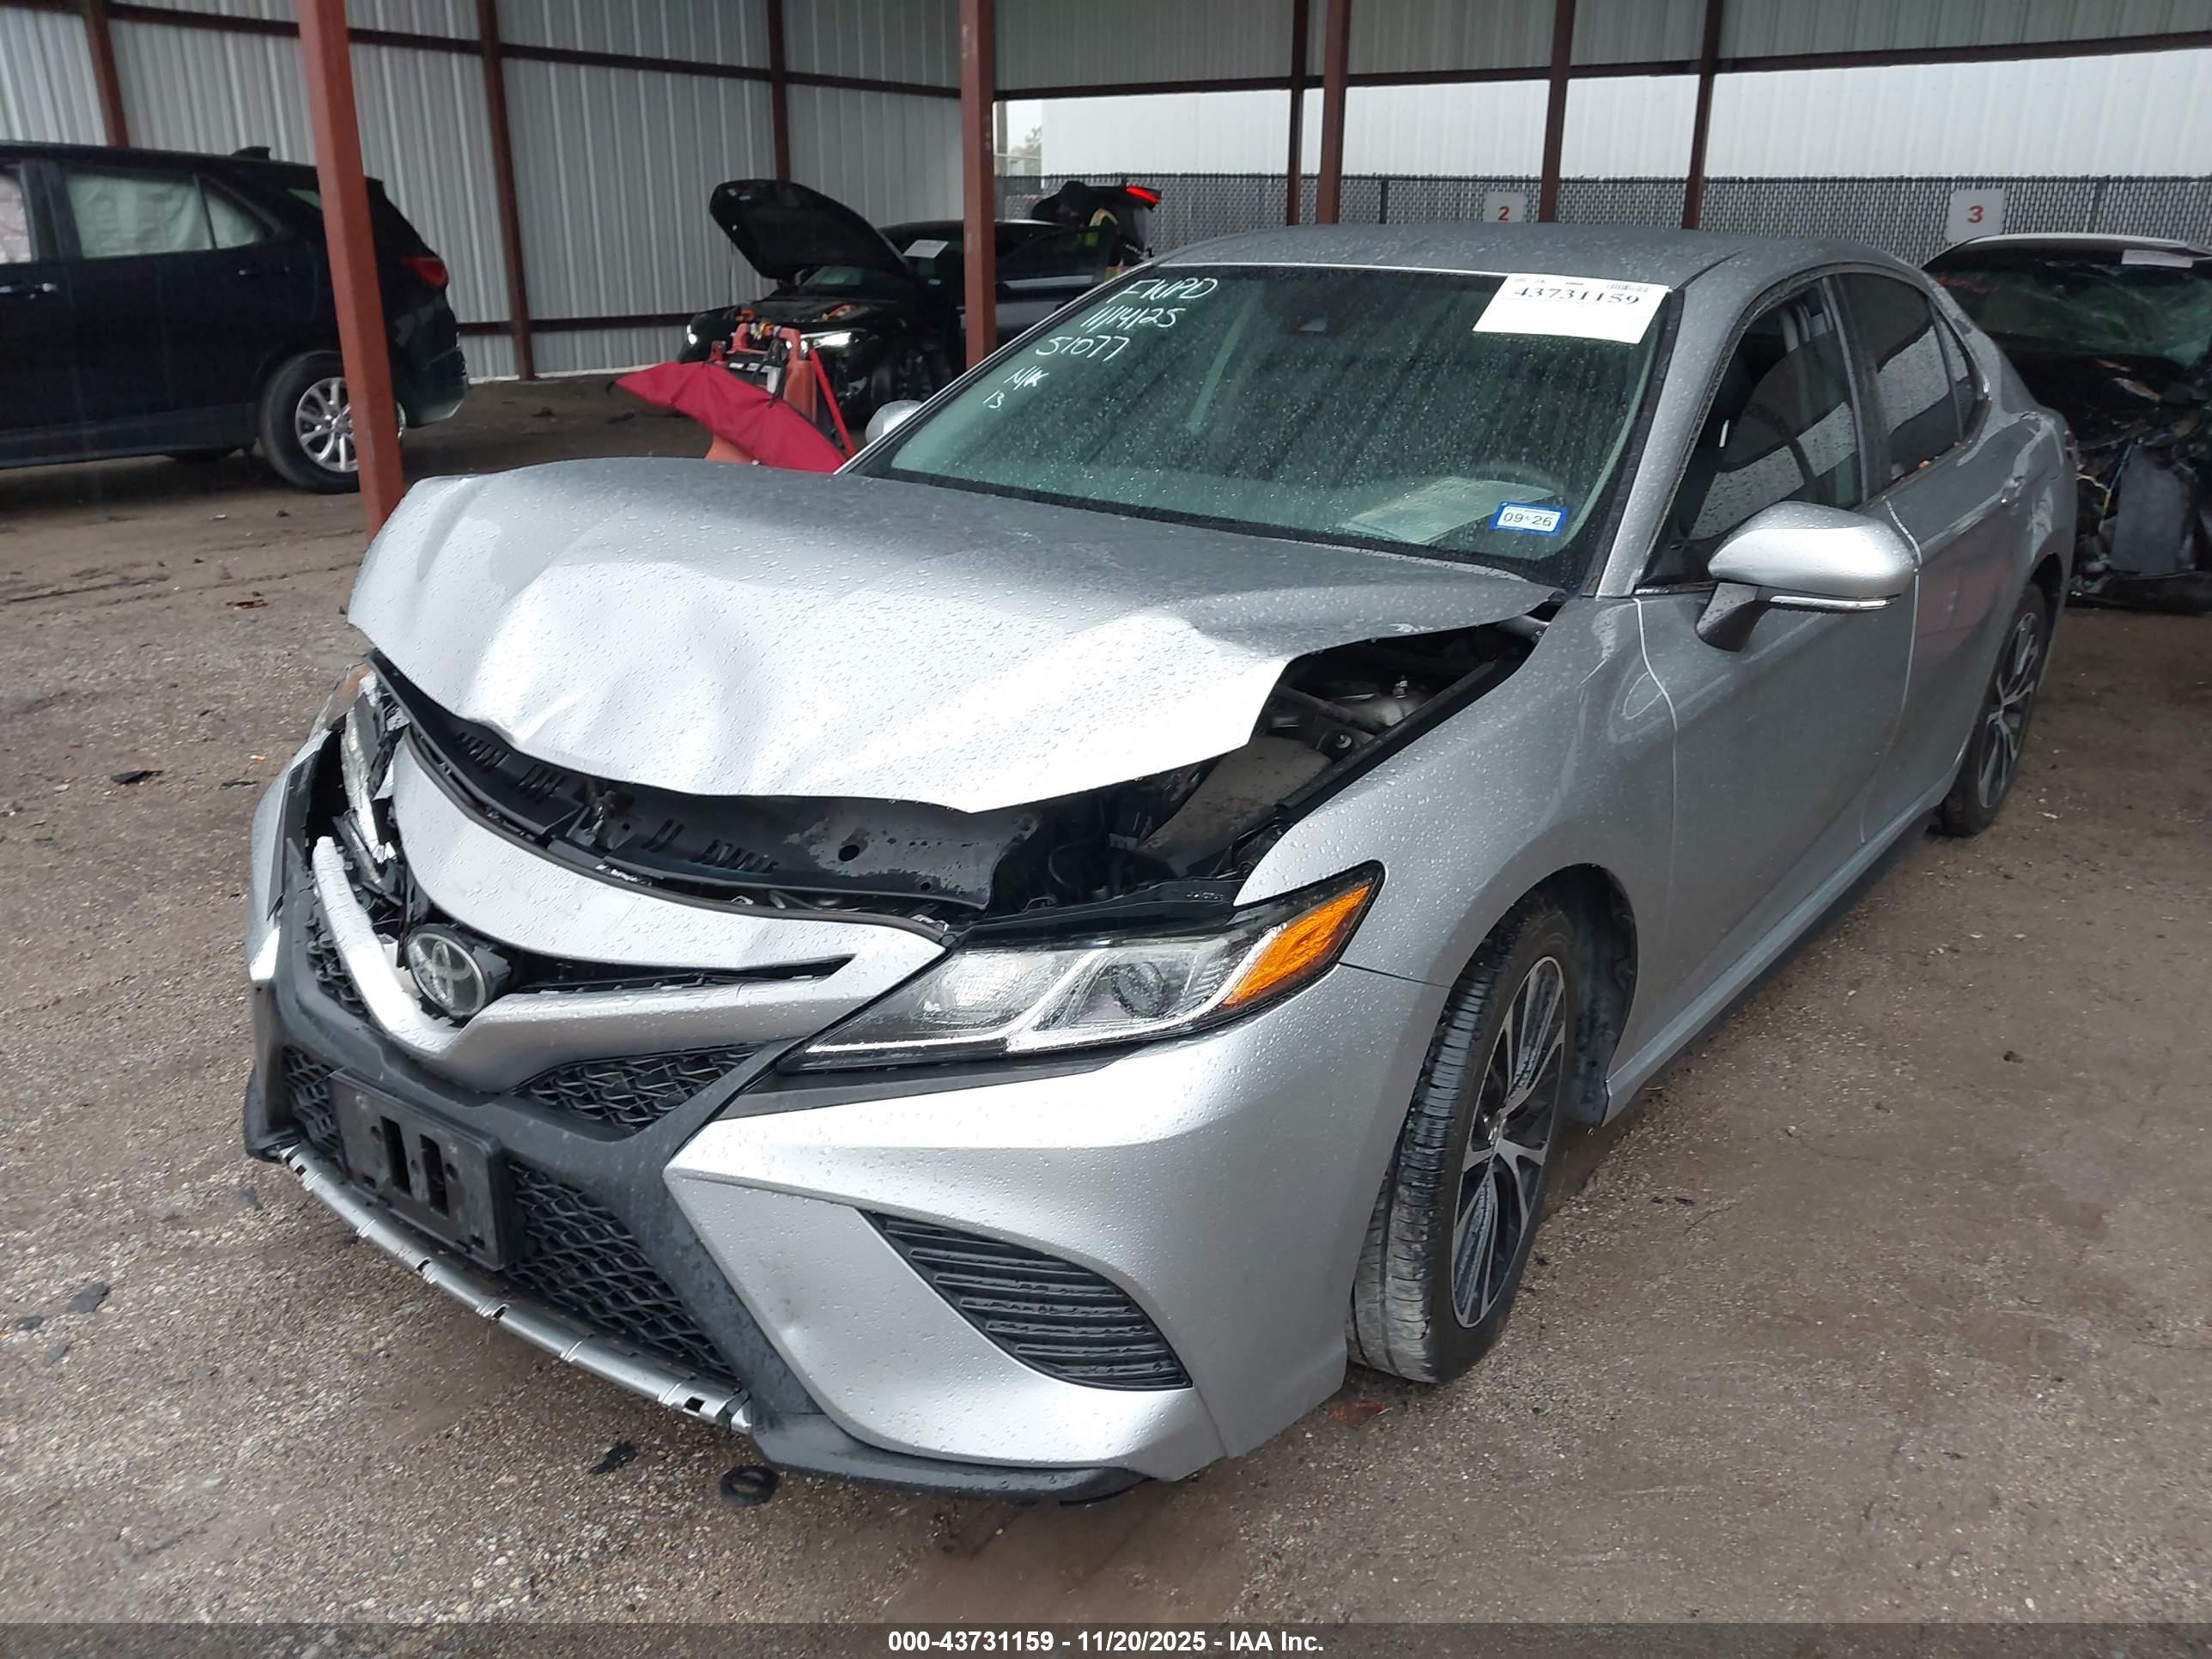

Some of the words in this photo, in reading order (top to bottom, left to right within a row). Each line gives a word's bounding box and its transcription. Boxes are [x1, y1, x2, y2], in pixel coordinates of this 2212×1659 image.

[1498, 205, 1510, 221] 2
[1967, 205, 1984, 223] 3
[1514, 286, 1640, 305] 43731159
[1079, 305, 1187, 334] 11/14/25
[1036, 336, 1131, 362] 51077
